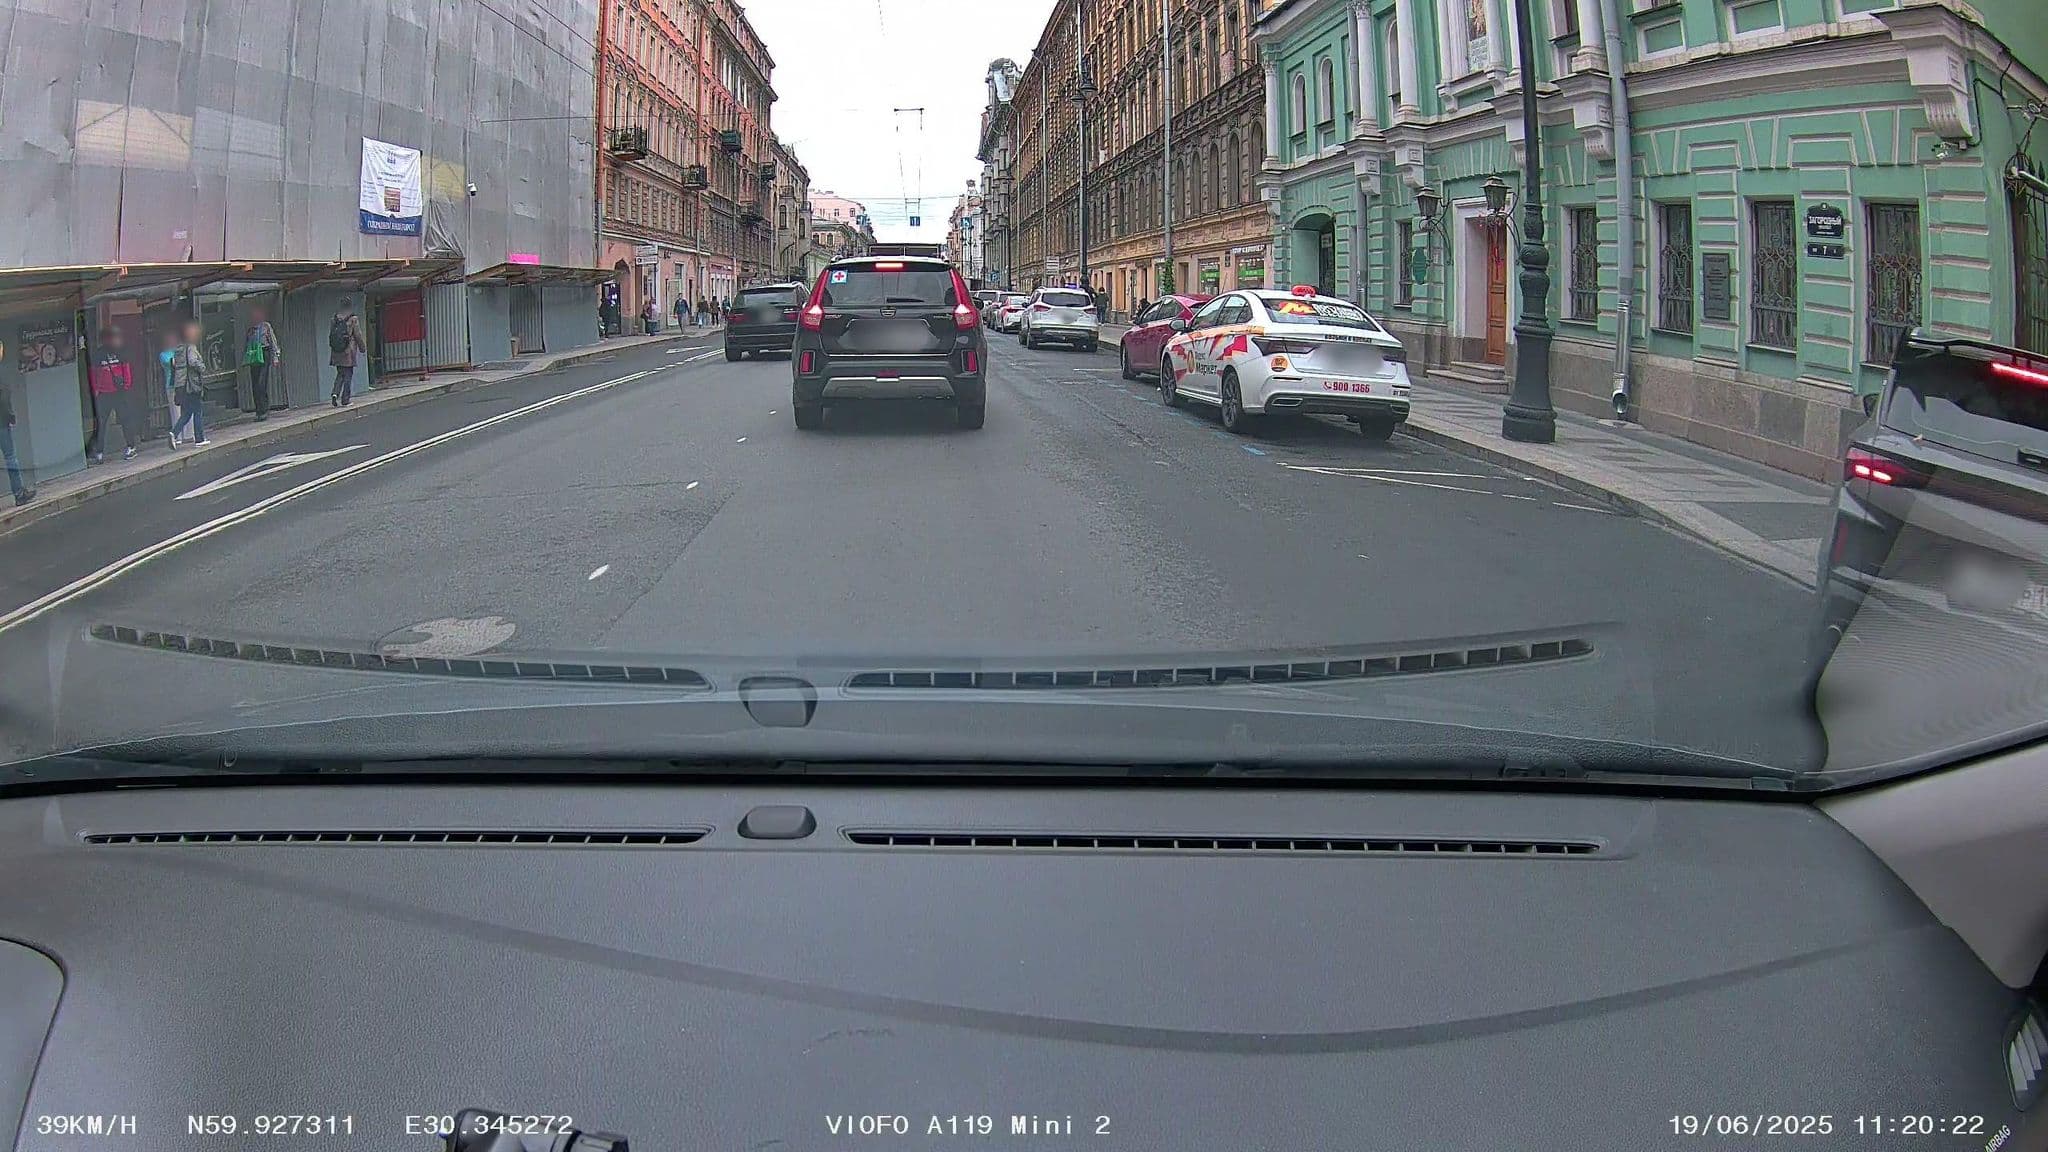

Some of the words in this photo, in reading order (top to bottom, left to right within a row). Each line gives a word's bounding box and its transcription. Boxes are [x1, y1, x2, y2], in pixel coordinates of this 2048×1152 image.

[1808, 216, 1842, 225] ЗАГОРОДНЫЙ
[1333, 382, 1348, 392] 900
[1984, 1124, 2011, 1152] AIRBAG
